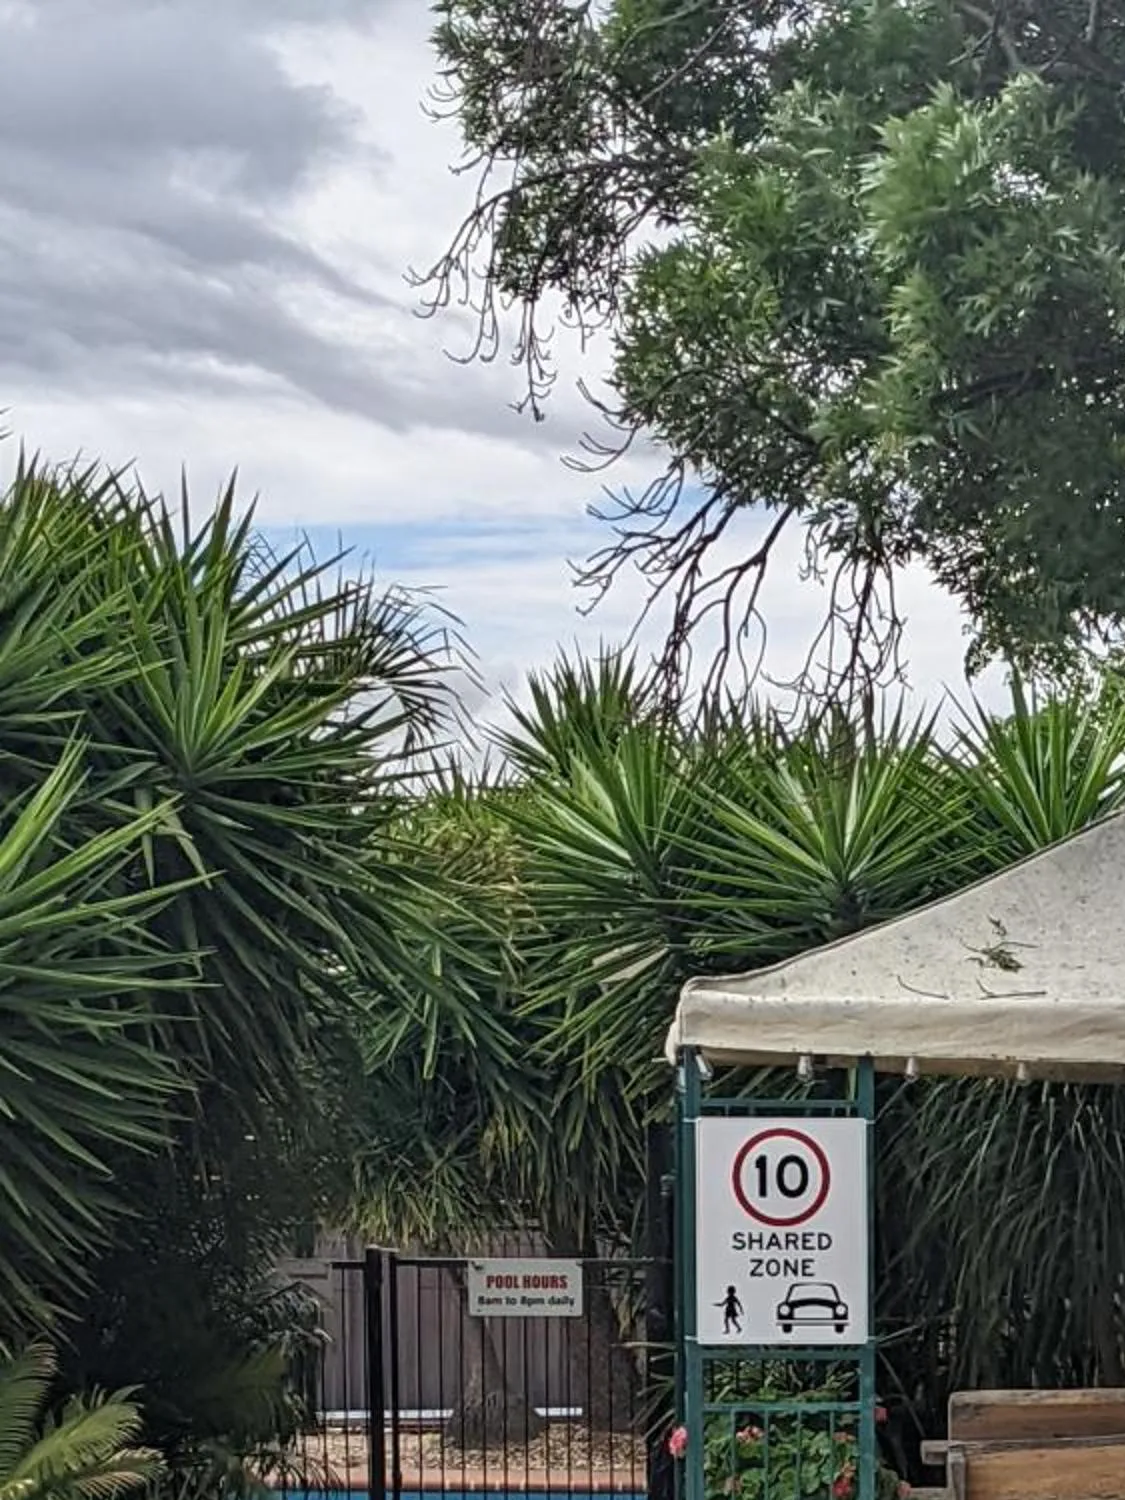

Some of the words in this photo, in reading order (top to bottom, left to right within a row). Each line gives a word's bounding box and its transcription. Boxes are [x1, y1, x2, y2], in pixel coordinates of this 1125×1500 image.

[755, 1154, 809, 1198] 10
[732, 1232, 832, 1251] SHARED
[749, 1259, 815, 1277] ZONE
[486, 1274, 519, 1289] POOL
[523, 1274, 568, 1289] HOURS
[506, 1295, 517, 1305] to
[548, 1295, 575, 1306] daily
